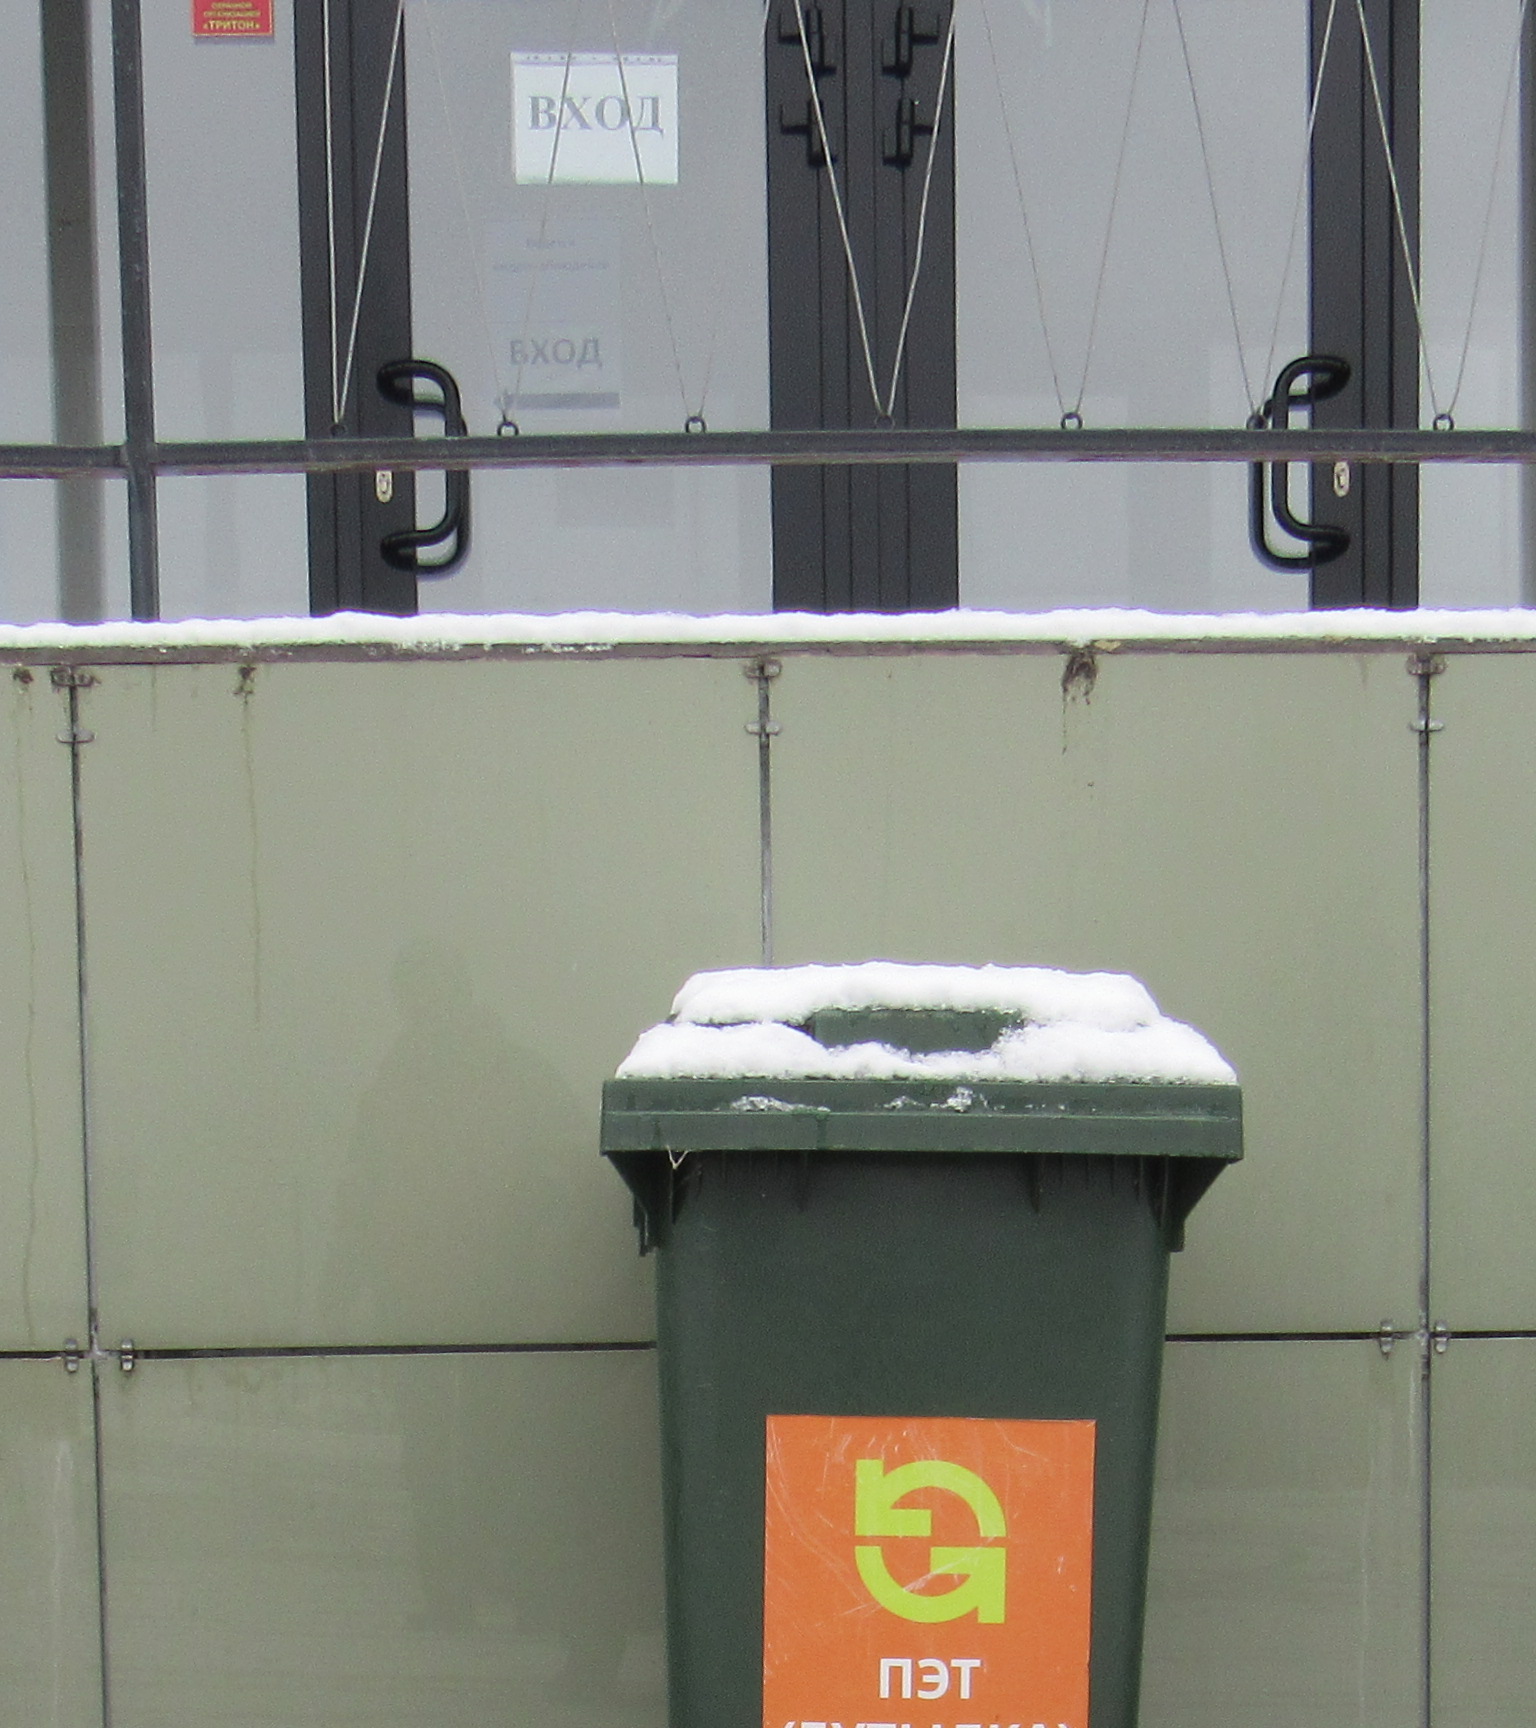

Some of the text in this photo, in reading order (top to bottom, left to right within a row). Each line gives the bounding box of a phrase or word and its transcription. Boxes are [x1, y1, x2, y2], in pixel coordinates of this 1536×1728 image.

[528, 95, 664, 138] ВХОД
[510, 337, 603, 370] ВХОД
[879, 1657, 982, 1700] ПЭТ
